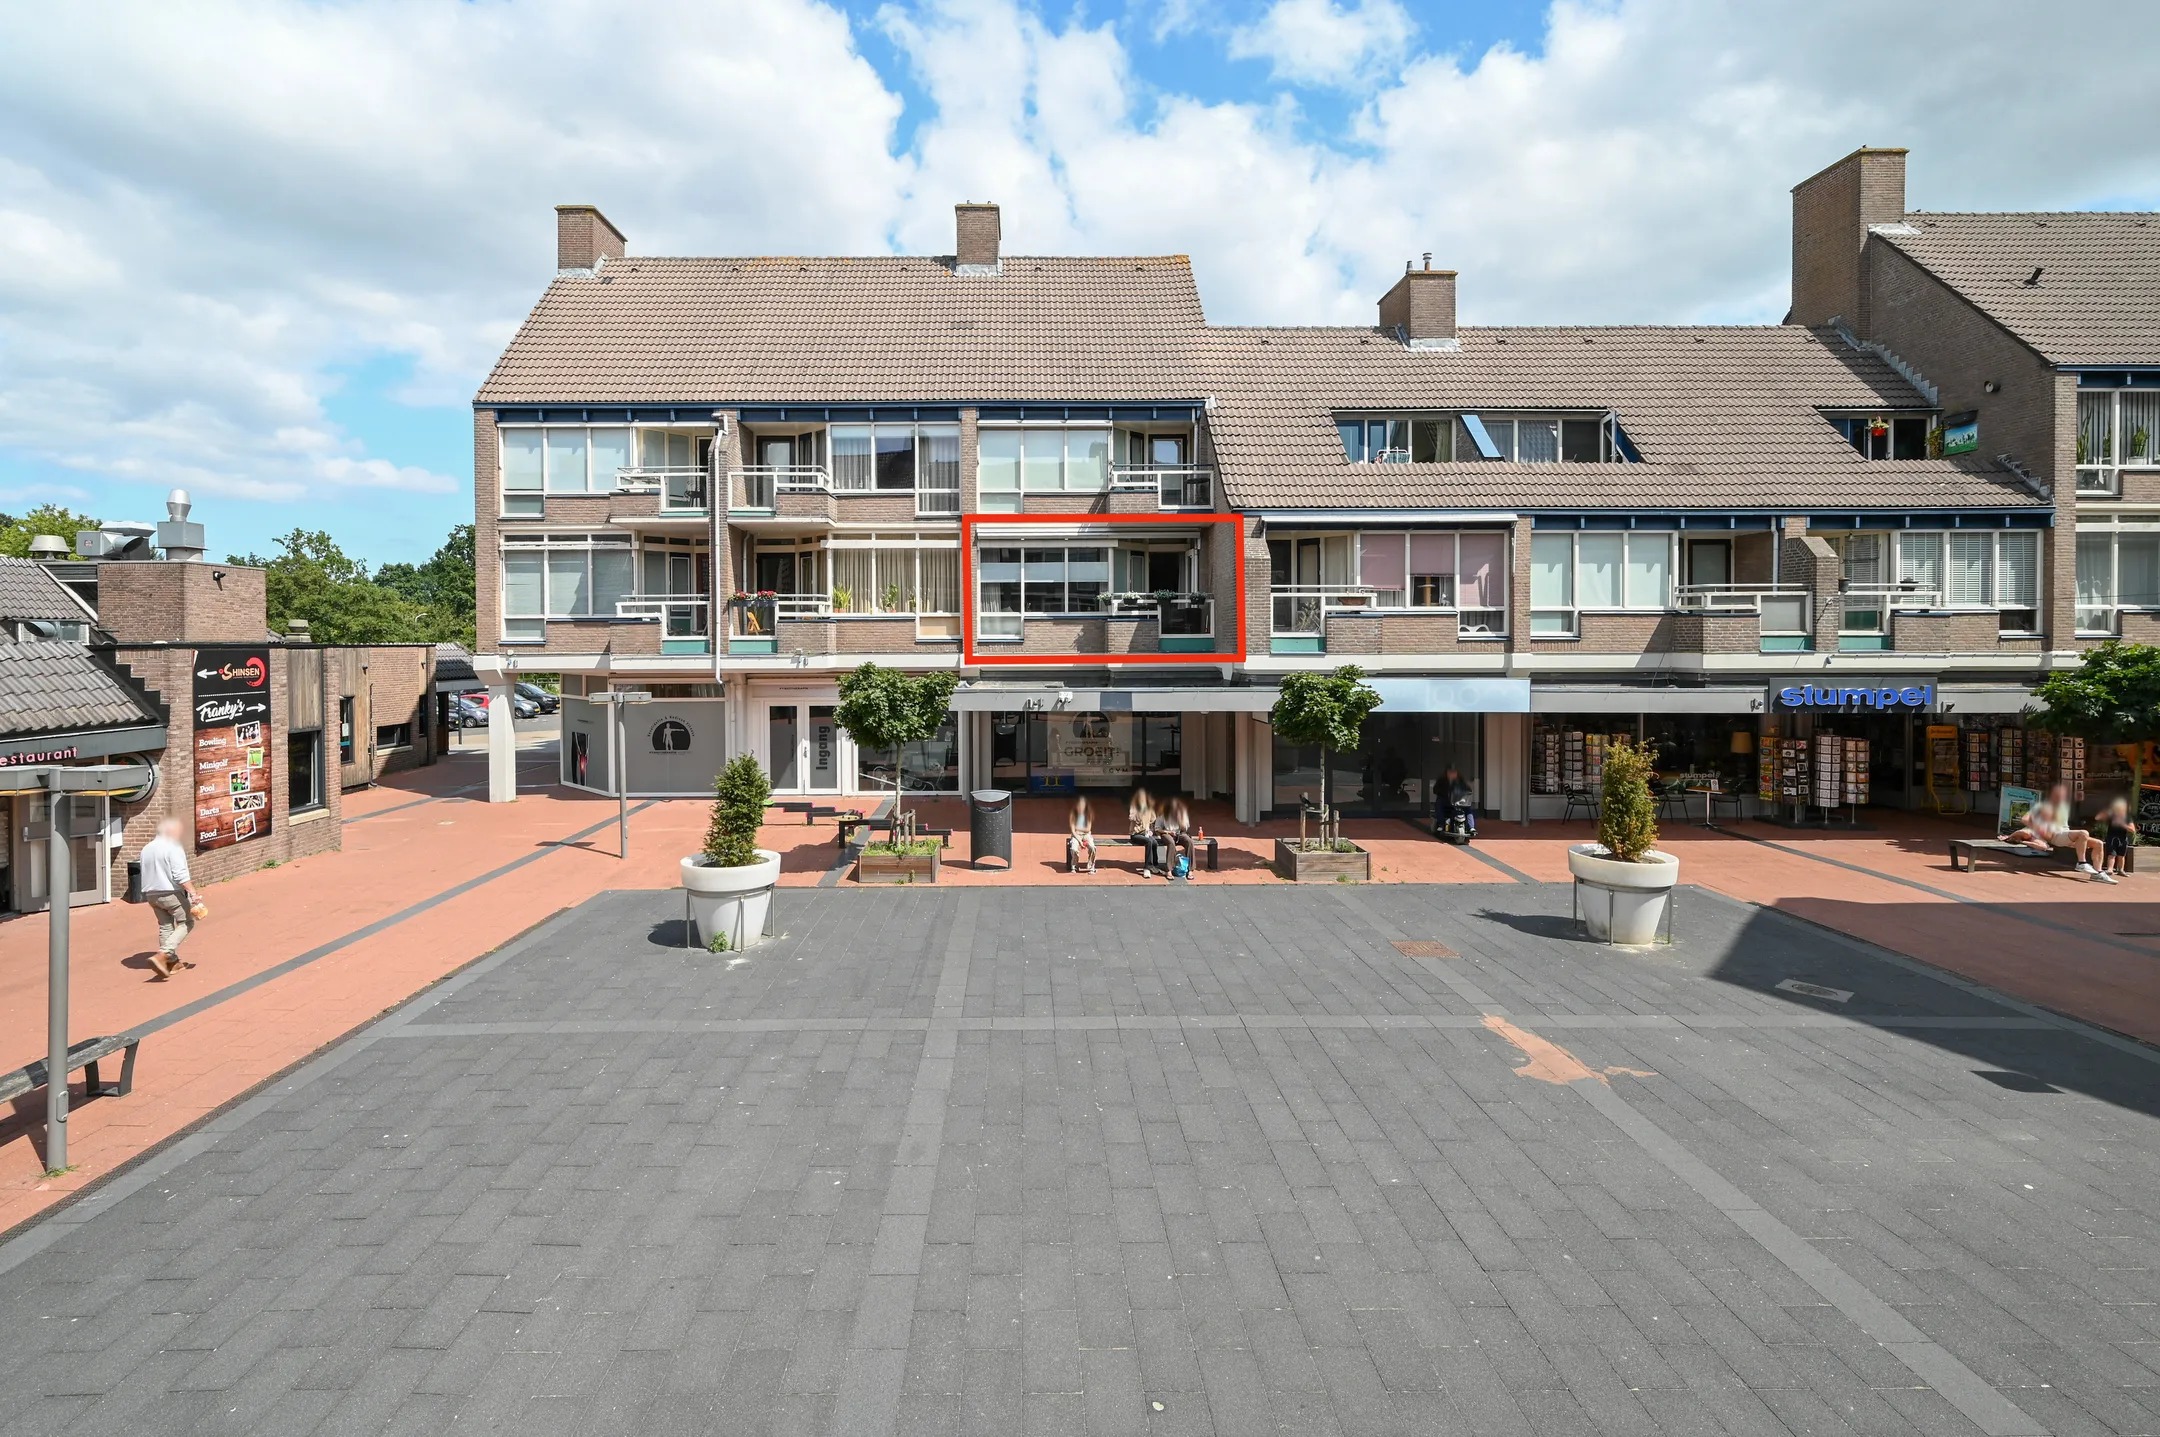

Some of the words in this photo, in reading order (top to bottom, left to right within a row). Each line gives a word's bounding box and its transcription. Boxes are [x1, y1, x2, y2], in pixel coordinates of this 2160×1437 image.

[222, 663, 260, 680] SHINSEN
[1780, 683, 1933, 710] stumpel
[196, 699, 245, 722] Franky's
[199, 737, 227, 747] Bowling
[816, 726, 830, 770] Ingang
[0, 746, 78, 767] estaurant
[199, 759, 229, 770] Minigolf
[199, 784, 215, 794] Pool
[199, 807, 220, 817] Darts
[199, 829, 218, 840] Food
